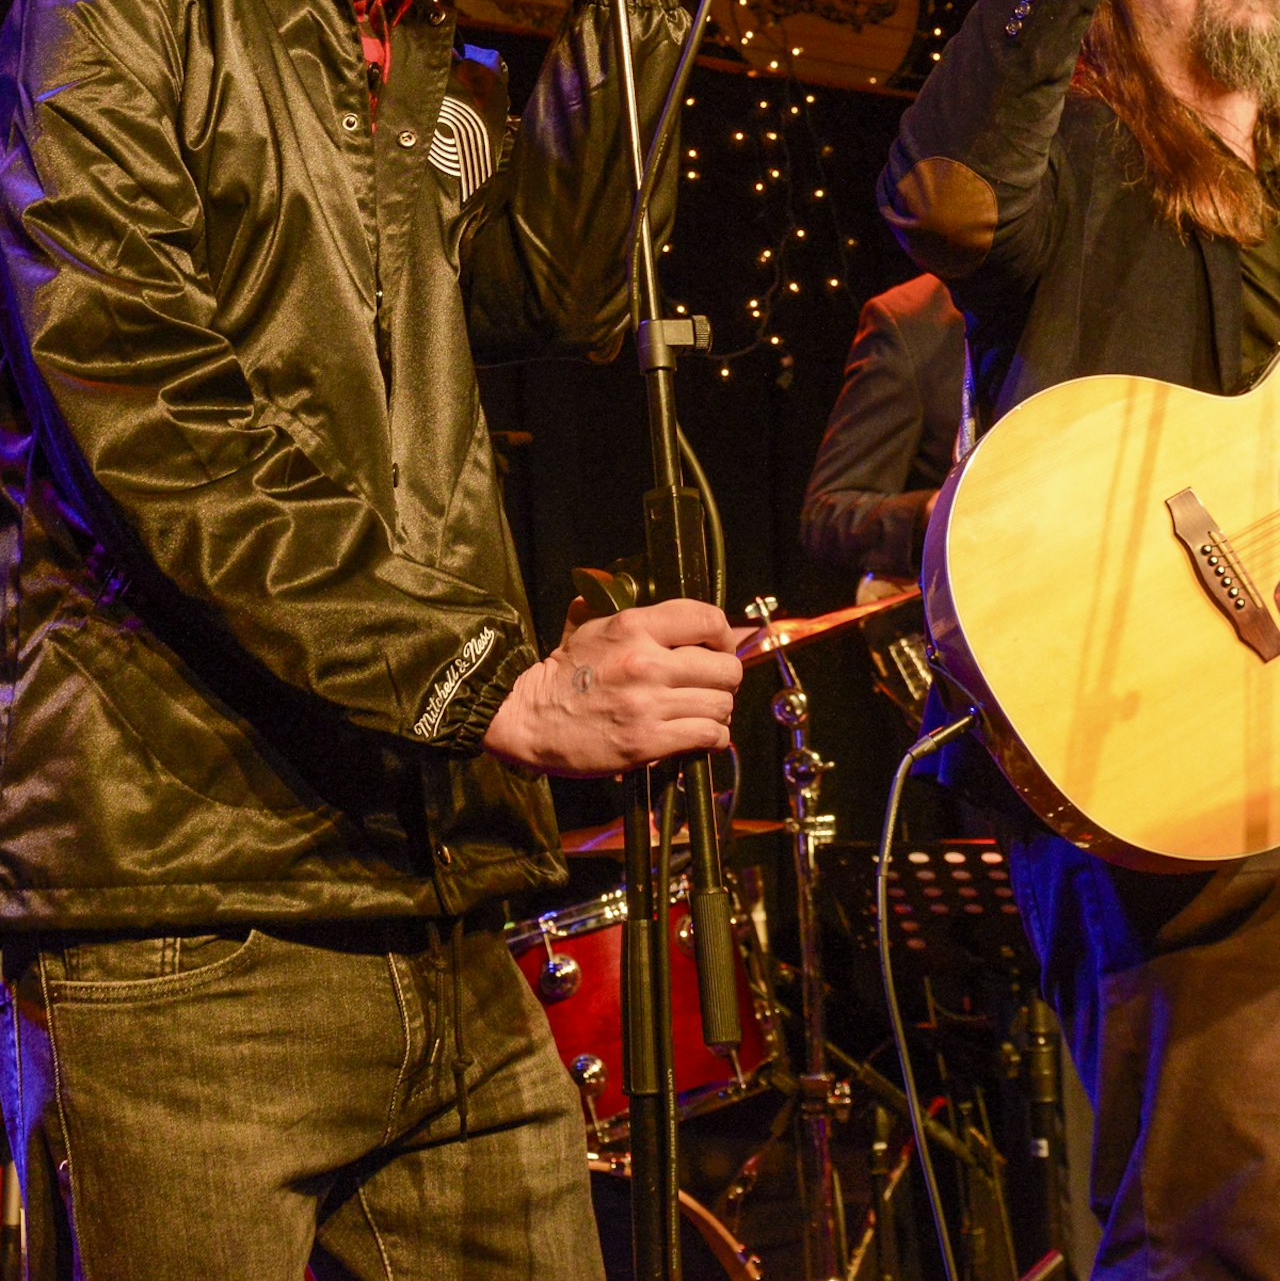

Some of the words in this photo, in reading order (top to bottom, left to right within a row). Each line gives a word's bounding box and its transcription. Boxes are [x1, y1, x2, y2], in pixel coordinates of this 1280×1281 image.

[462, 626, 496, 664] Ness
[454, 658, 471, 674] &
[413, 664, 460, 738] Mitchell
